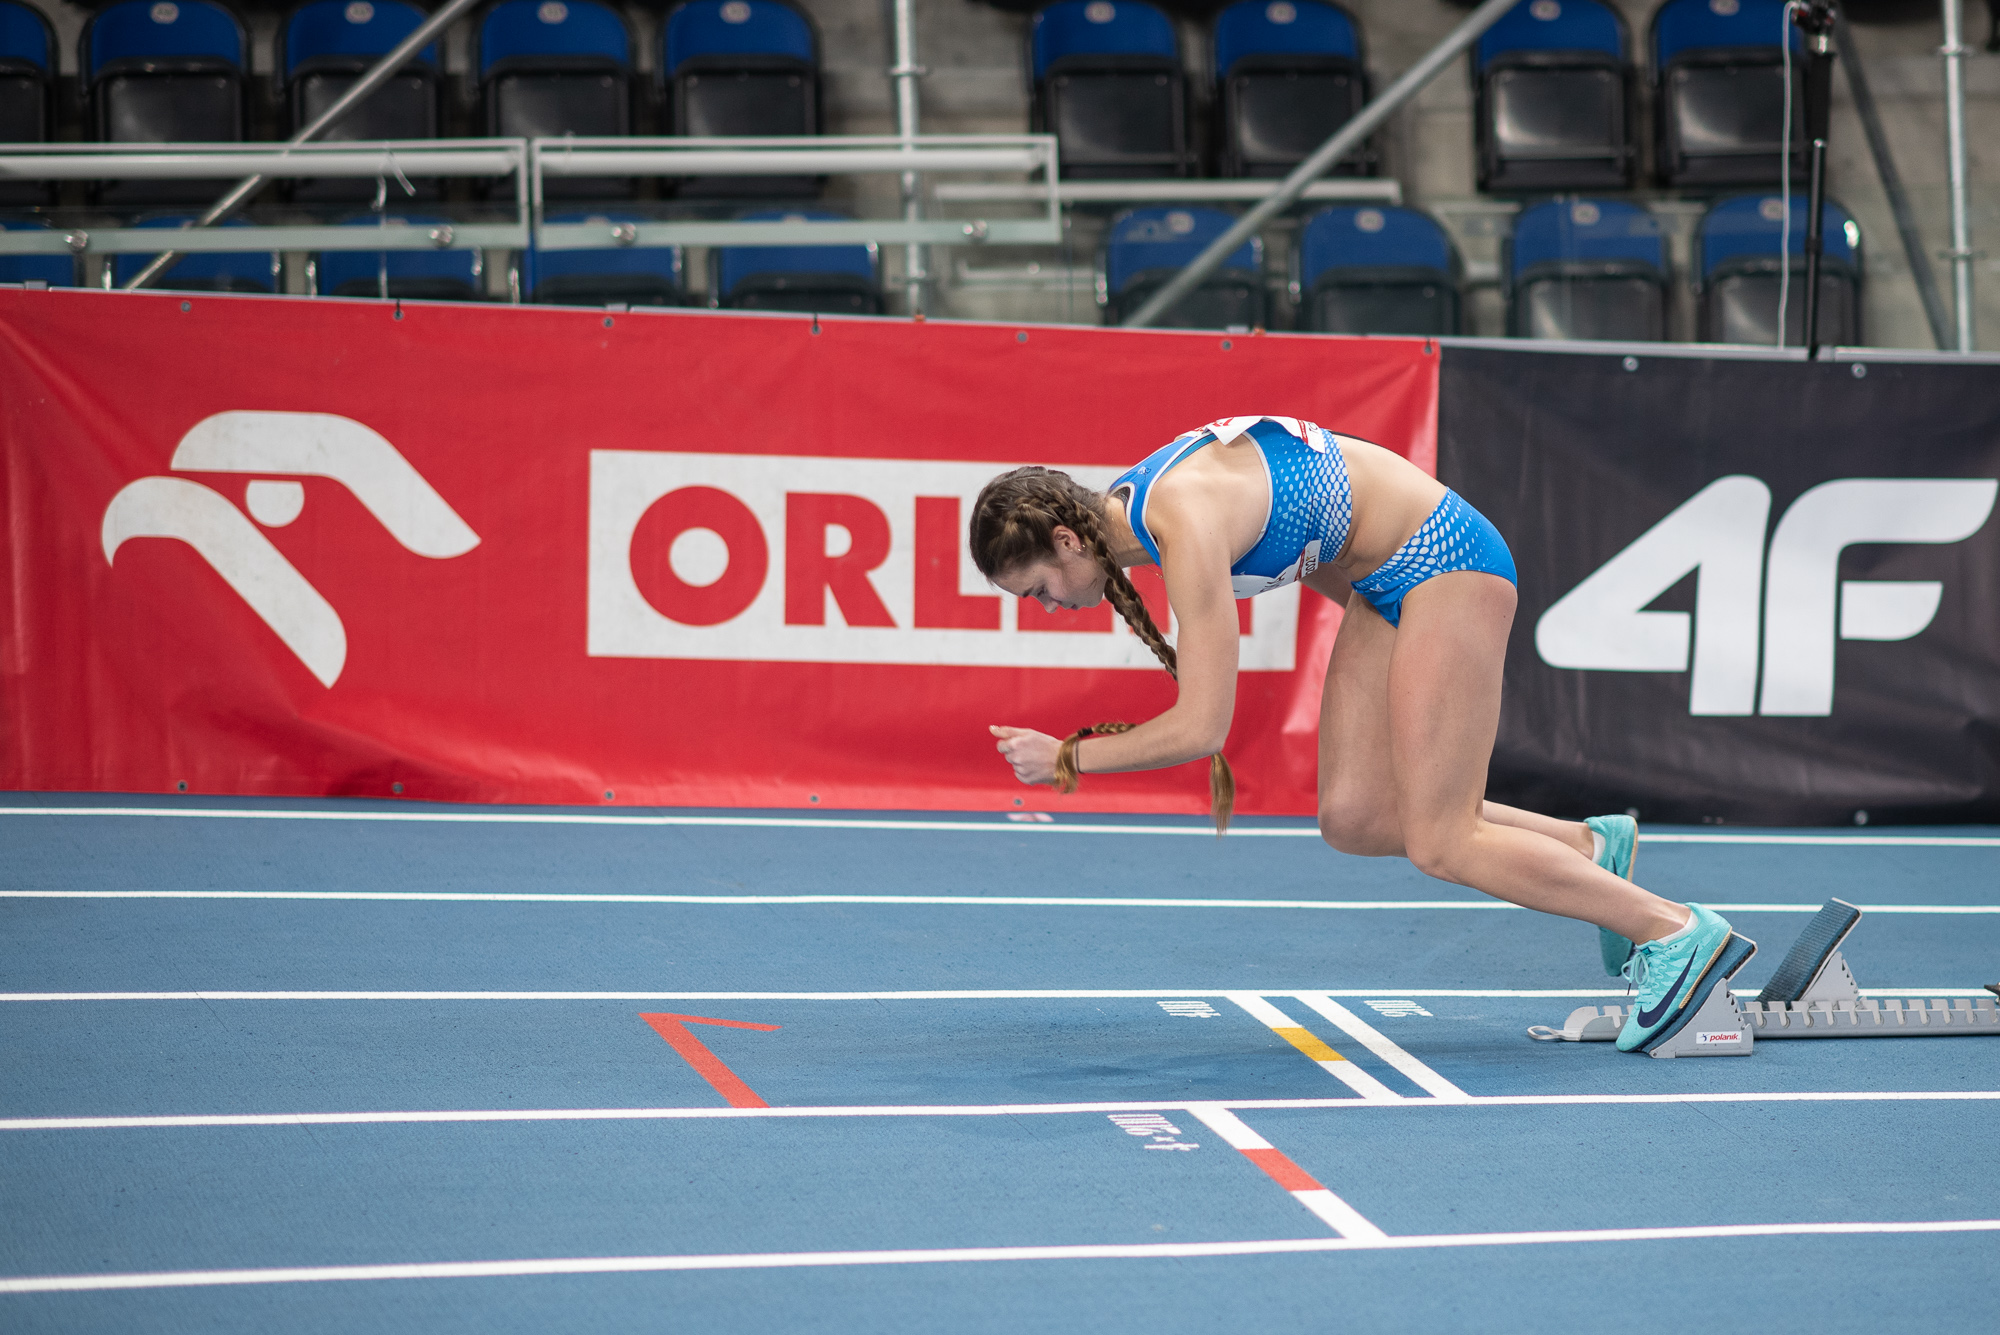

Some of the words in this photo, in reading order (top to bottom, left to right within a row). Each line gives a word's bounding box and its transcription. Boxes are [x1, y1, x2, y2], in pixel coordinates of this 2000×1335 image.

[629, 484, 1252, 635] ORL
[1535, 475, 1998, 717] 4F
[1709, 1033, 1739, 1042] polanik
